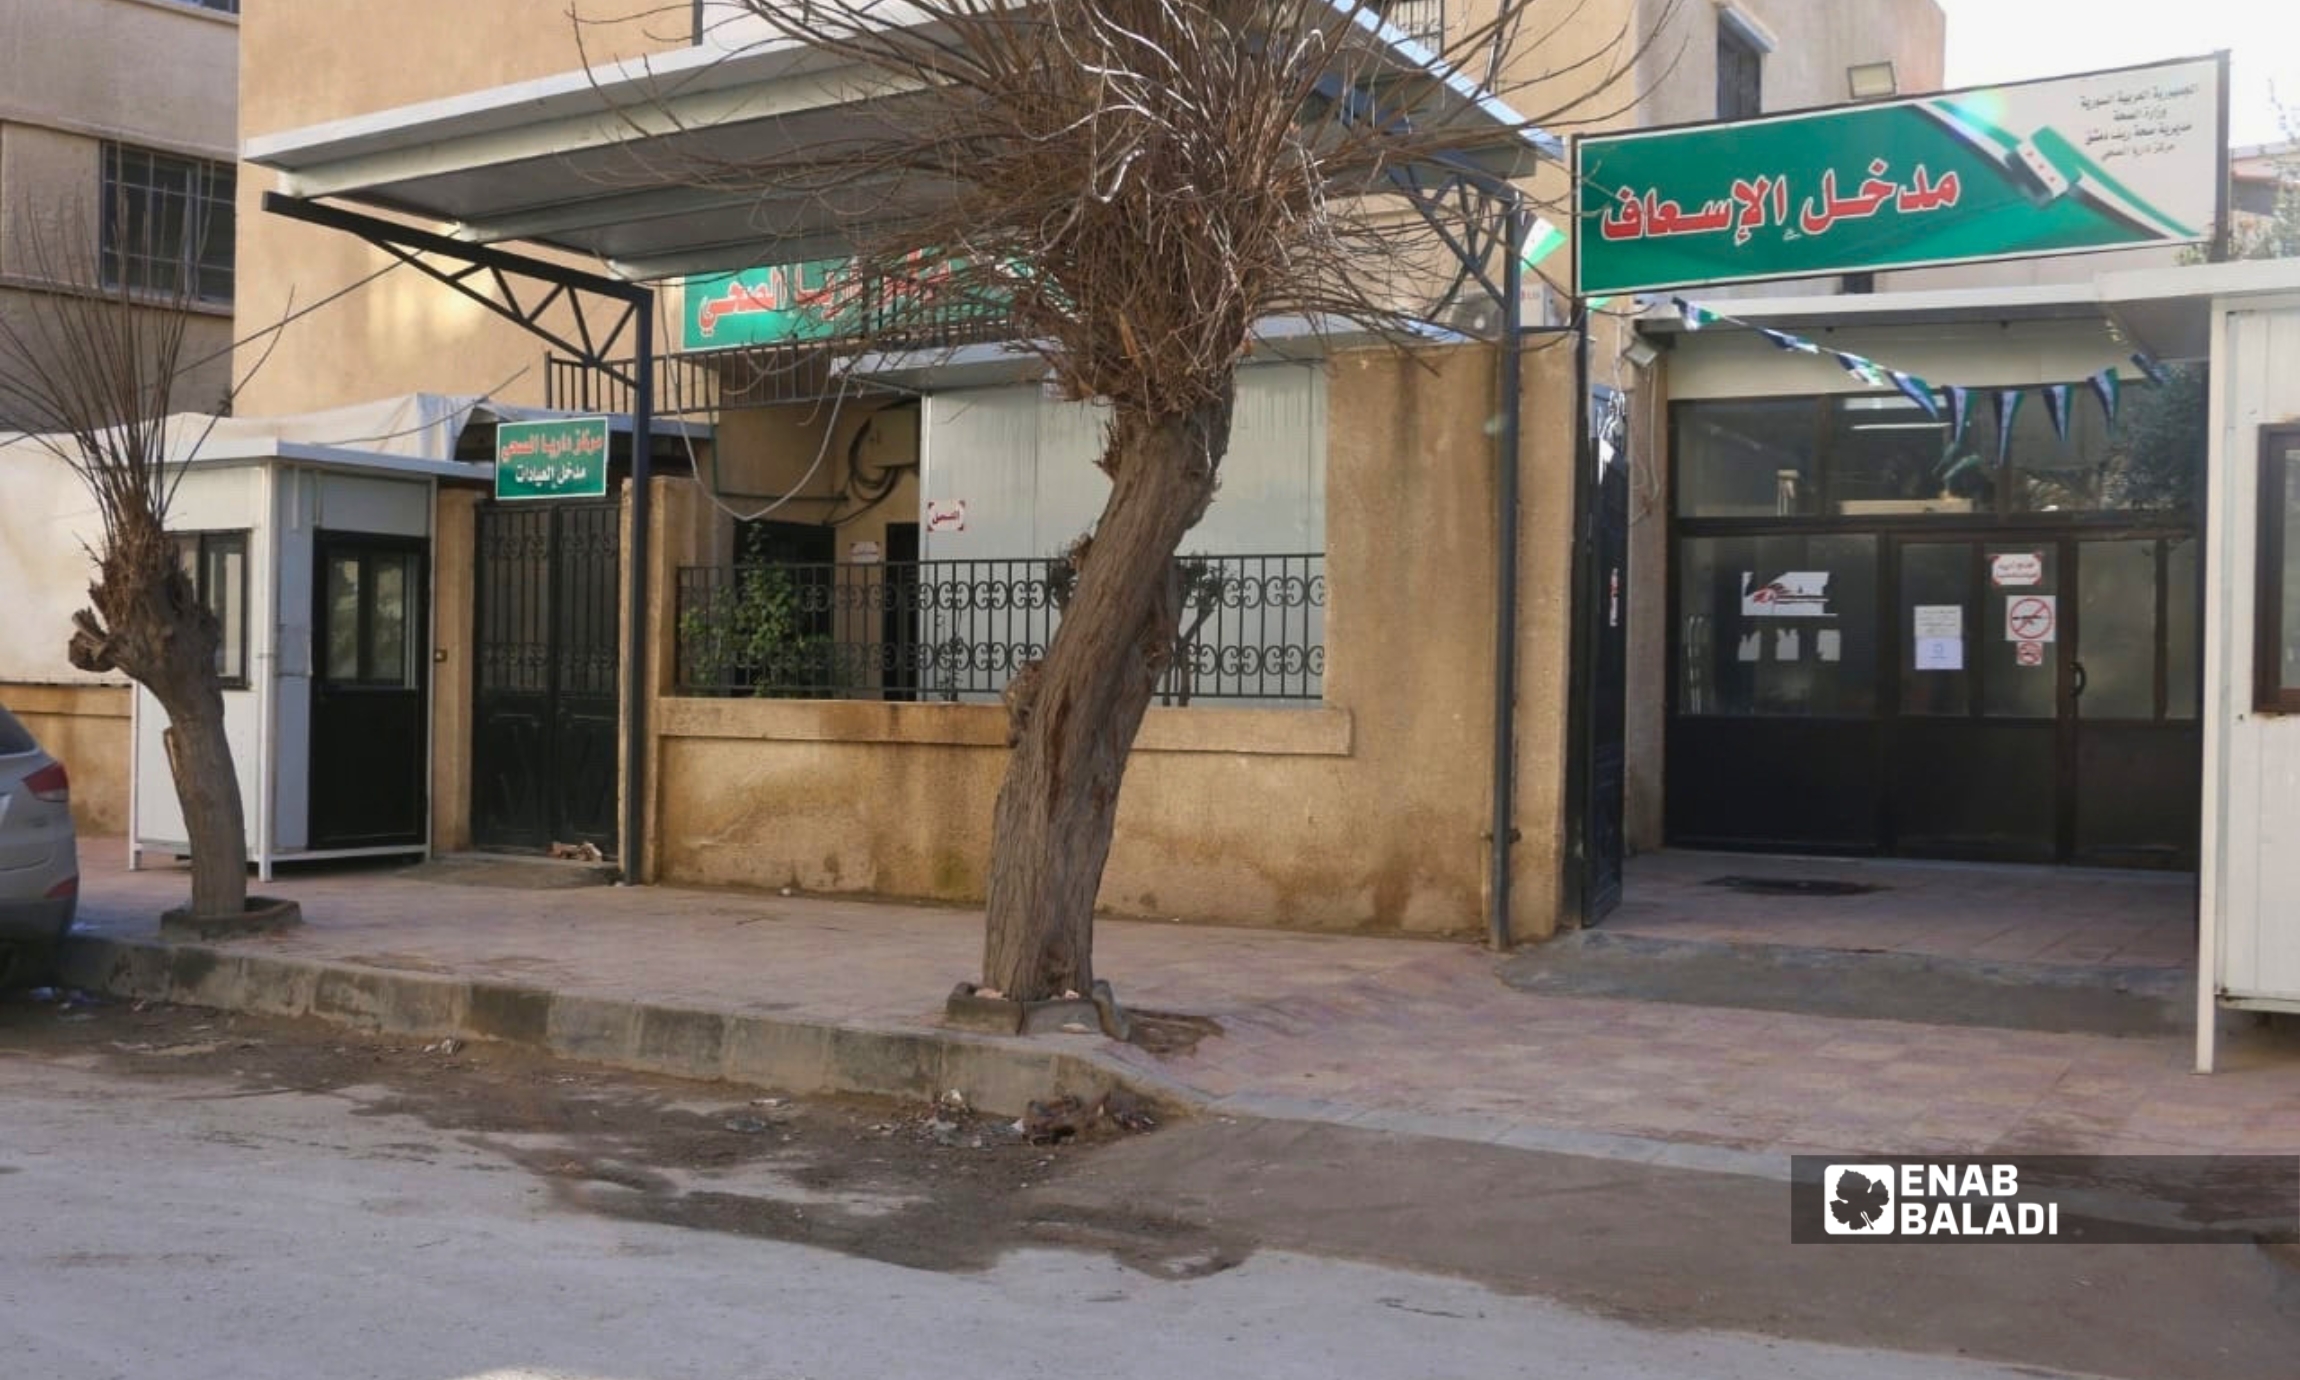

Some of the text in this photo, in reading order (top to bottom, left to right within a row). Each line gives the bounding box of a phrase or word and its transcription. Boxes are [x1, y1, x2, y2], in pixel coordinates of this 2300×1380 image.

[1601, 157, 1960, 247] مدخل الإسعاف
[699, 264, 788, 338] الصحي
[501, 433, 541, 463] الصحي
[572, 427, 605, 456] مركز
[557, 462, 587, 485] مدخل
